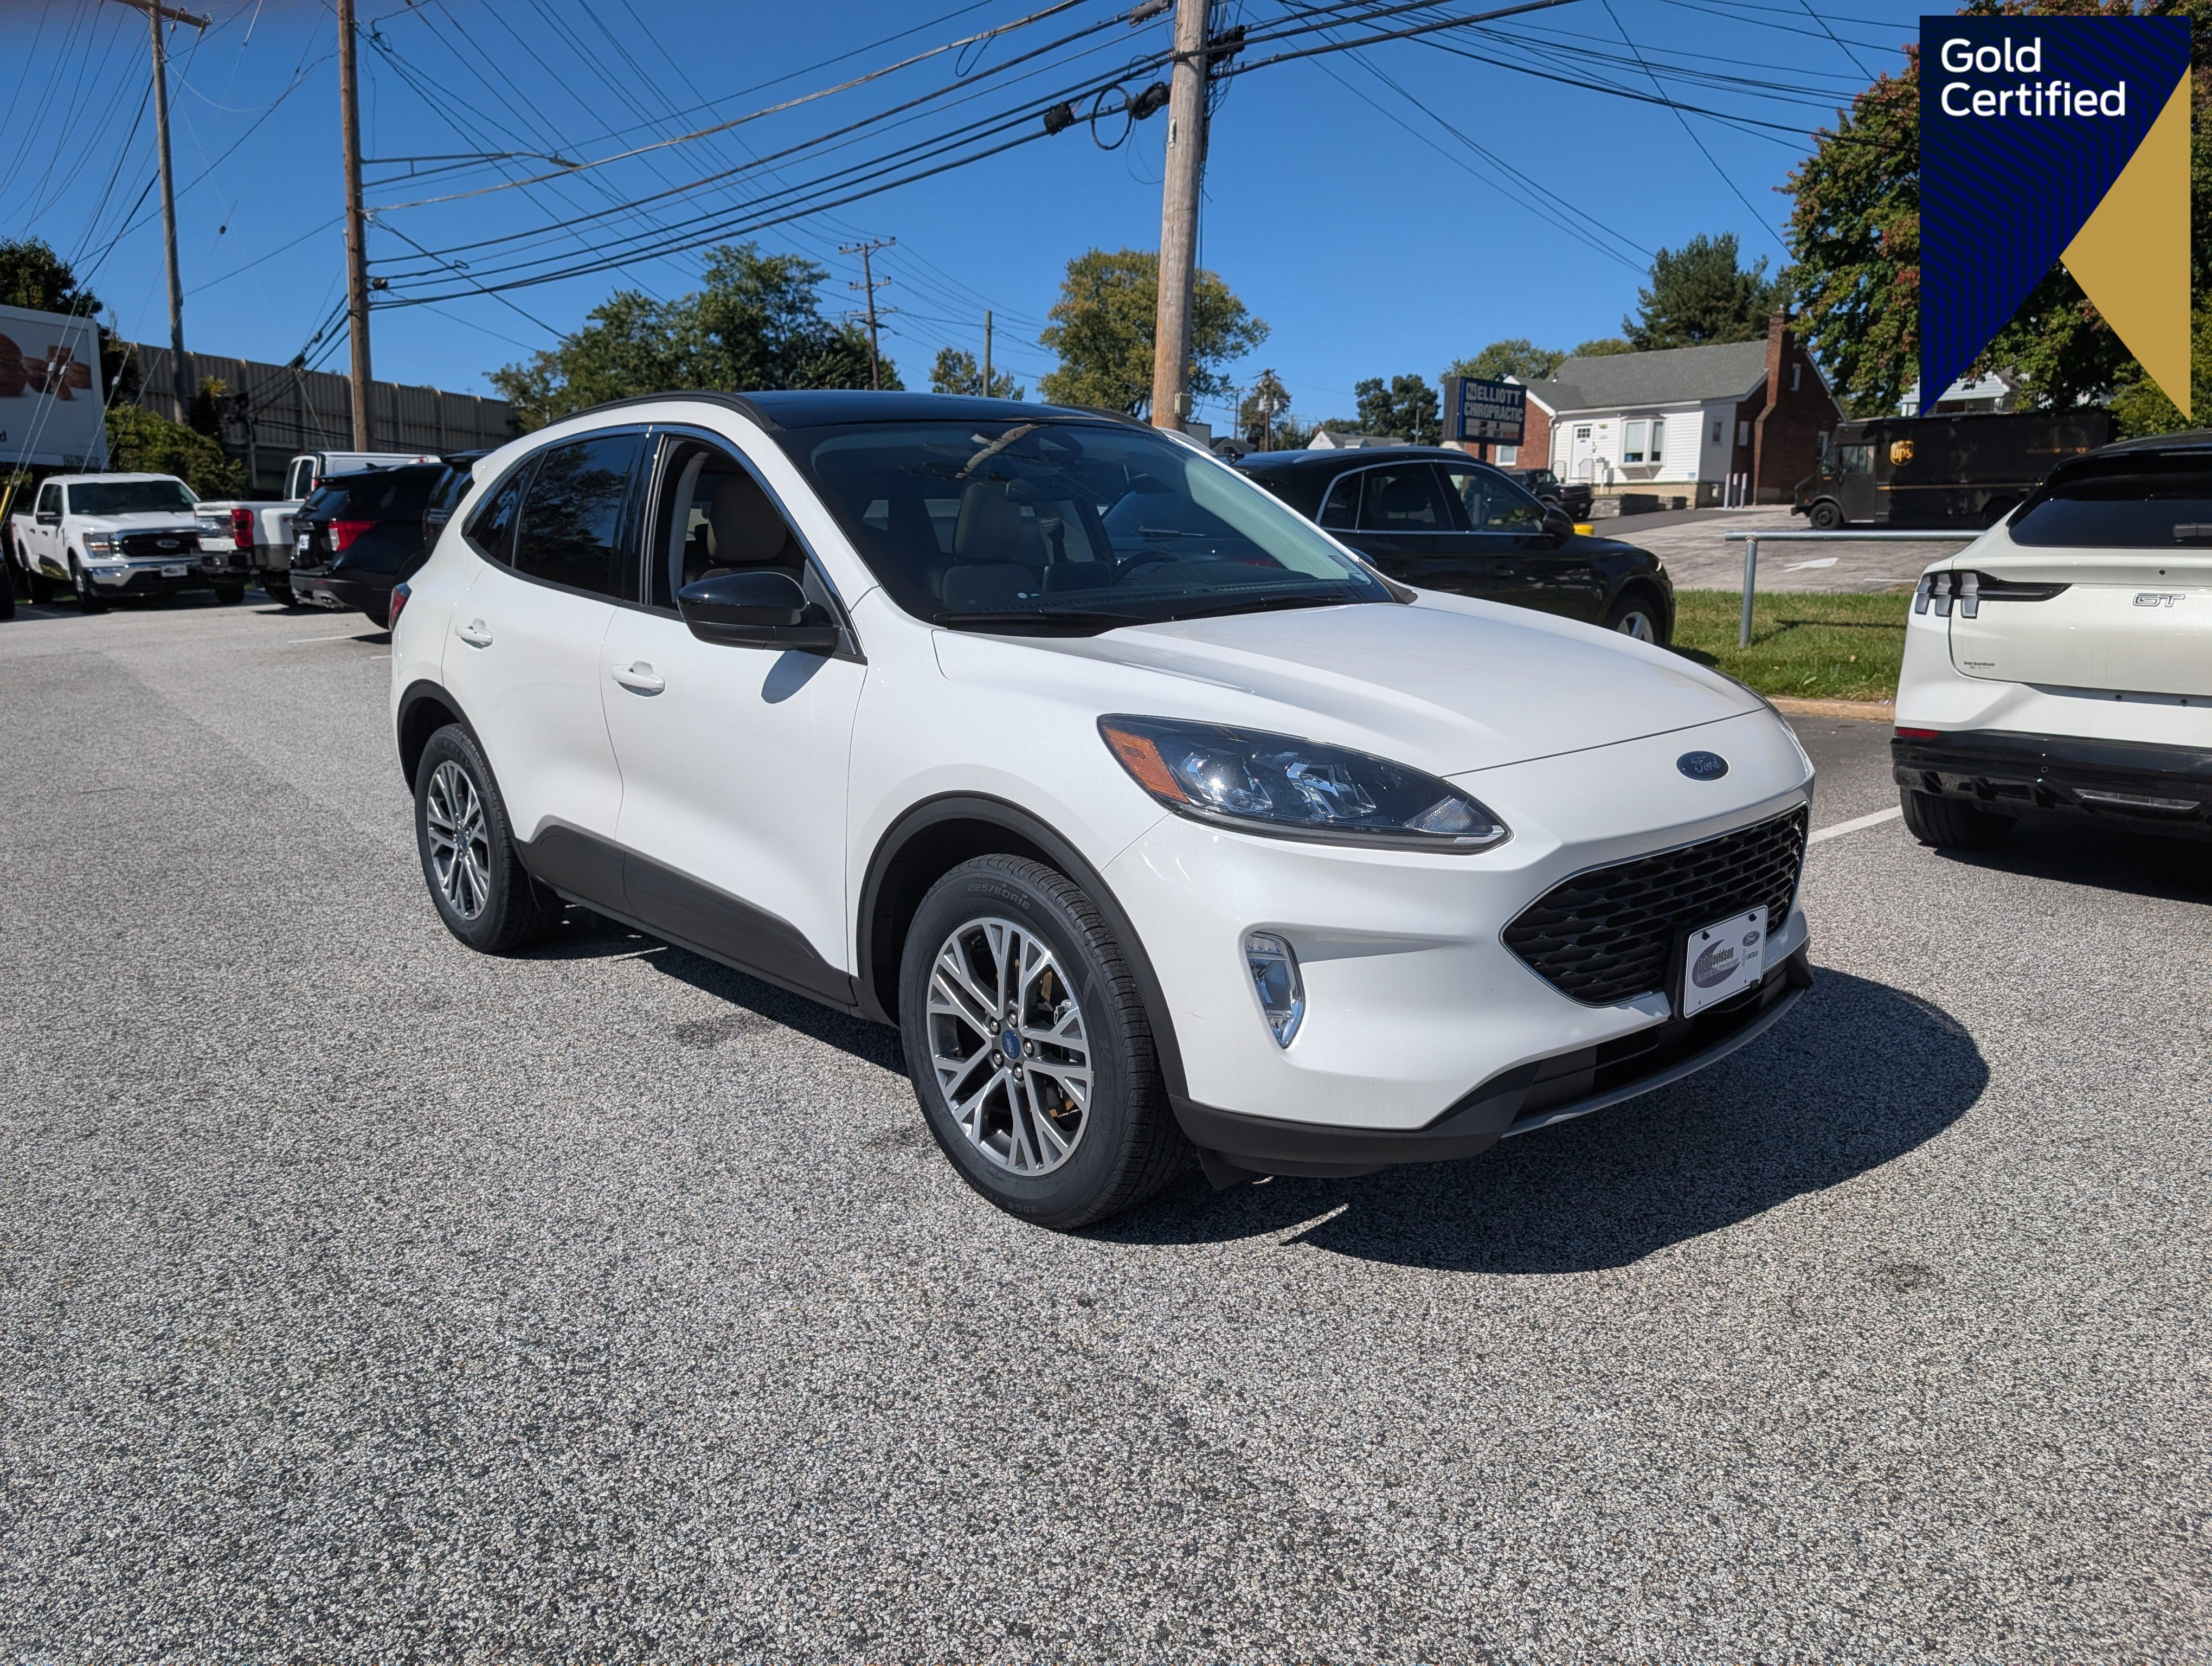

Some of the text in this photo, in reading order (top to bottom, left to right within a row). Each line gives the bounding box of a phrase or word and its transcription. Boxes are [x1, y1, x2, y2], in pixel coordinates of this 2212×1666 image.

[1478, 386, 1521, 405] ELLIOTT
[1463, 401, 1523, 422] CHIROPRACTIC
[1892, 448, 1913, 463] ups
[2132, 592, 2186, 608] GT
[968, 884, 1030, 910] 225/60R18
[1698, 957, 1709, 972] Bob
[1709, 947, 1734, 966] Davidson
